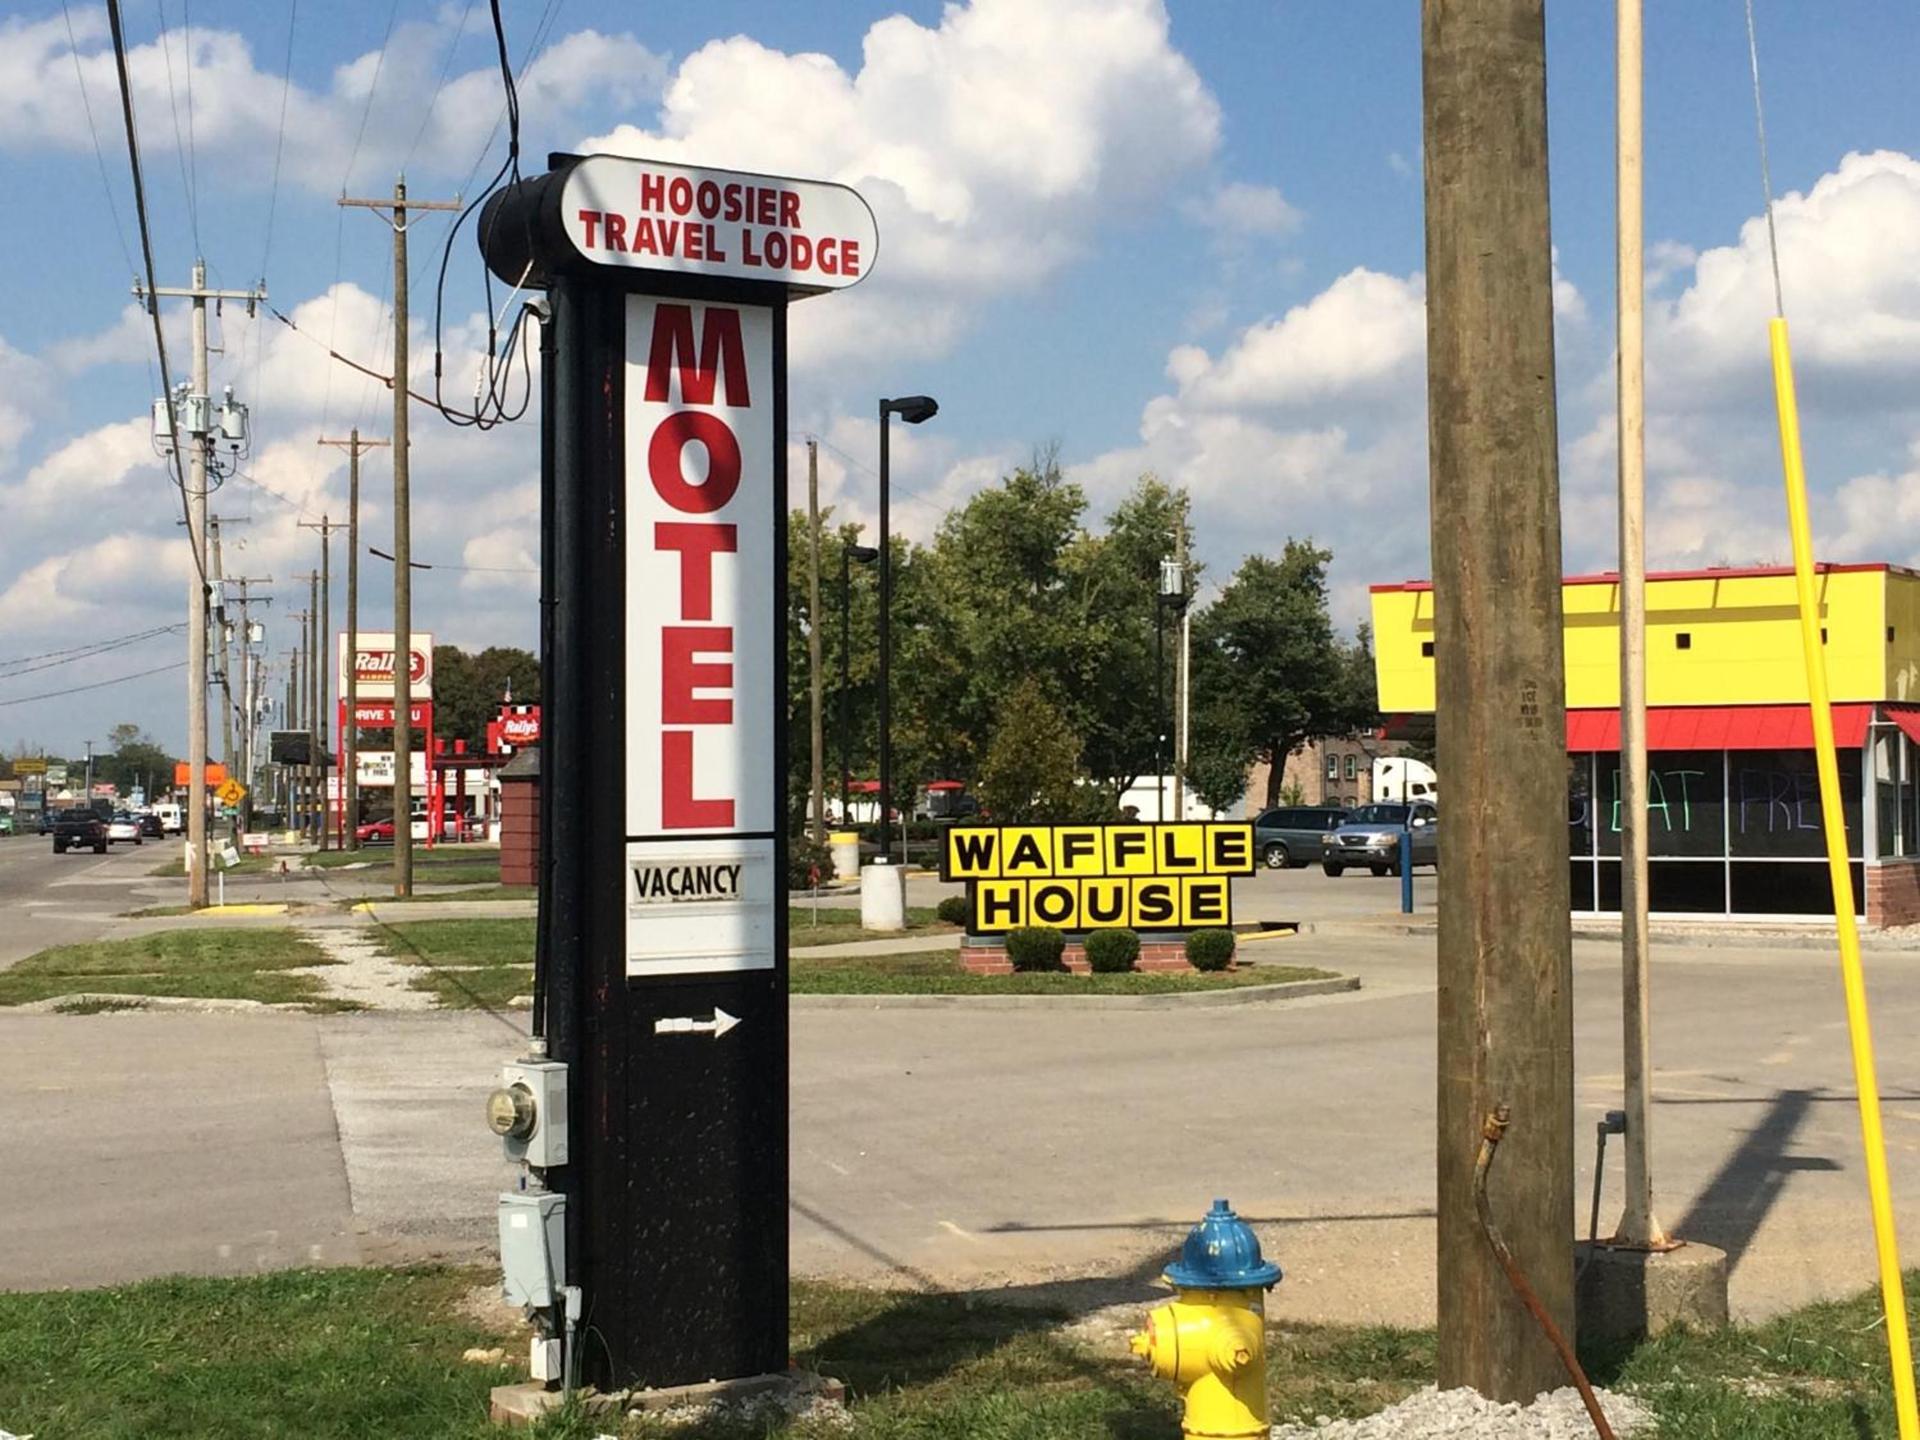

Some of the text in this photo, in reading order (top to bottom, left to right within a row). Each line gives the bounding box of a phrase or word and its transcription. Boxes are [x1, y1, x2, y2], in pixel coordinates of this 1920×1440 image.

[641, 173, 801, 229] HOOSIER
[579, 209, 860, 277] TRAVEL LODGE
[643, 303, 751, 830] MOTEL
[356, 652, 419, 675] Rall's
[388, 709, 421, 721] TU
[1611, 769, 1704, 832] EAT
[954, 831, 1247, 871] WAFFLE
[634, 864, 742, 898] VACANCY
[984, 884, 1222, 925] HOUSE
